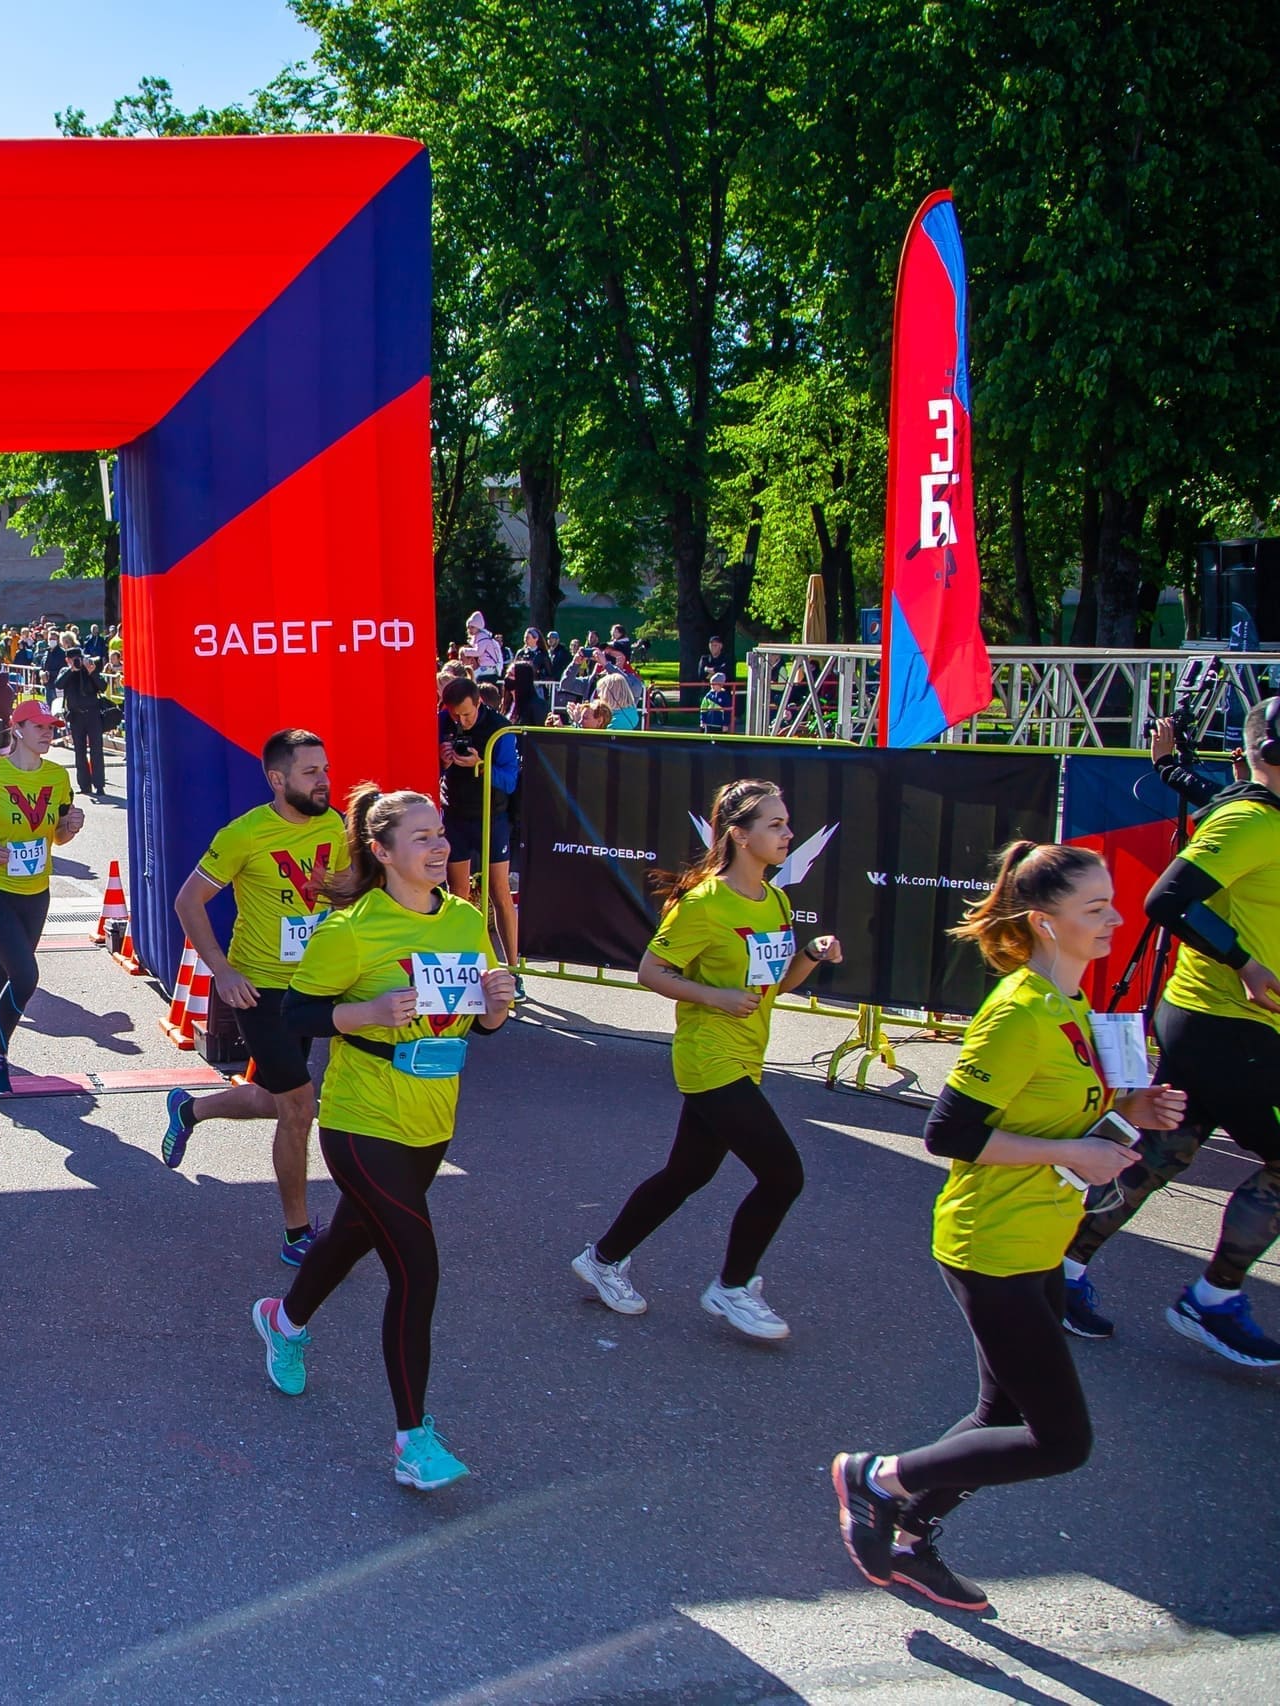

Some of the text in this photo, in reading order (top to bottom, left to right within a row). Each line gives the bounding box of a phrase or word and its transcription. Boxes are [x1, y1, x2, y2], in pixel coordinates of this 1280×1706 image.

[193, 618, 415, 657] ЗАБЕГ.РФ
[13, 846, 45, 860] 10131
[552, 842, 657, 861] ЛИГАГЕРОЕВ.РФ
[288, 925, 314, 940] 101
[756, 942, 794, 960] 10120
[421, 967, 480, 985] 10140
[448, 994, 456, 1004] 5
